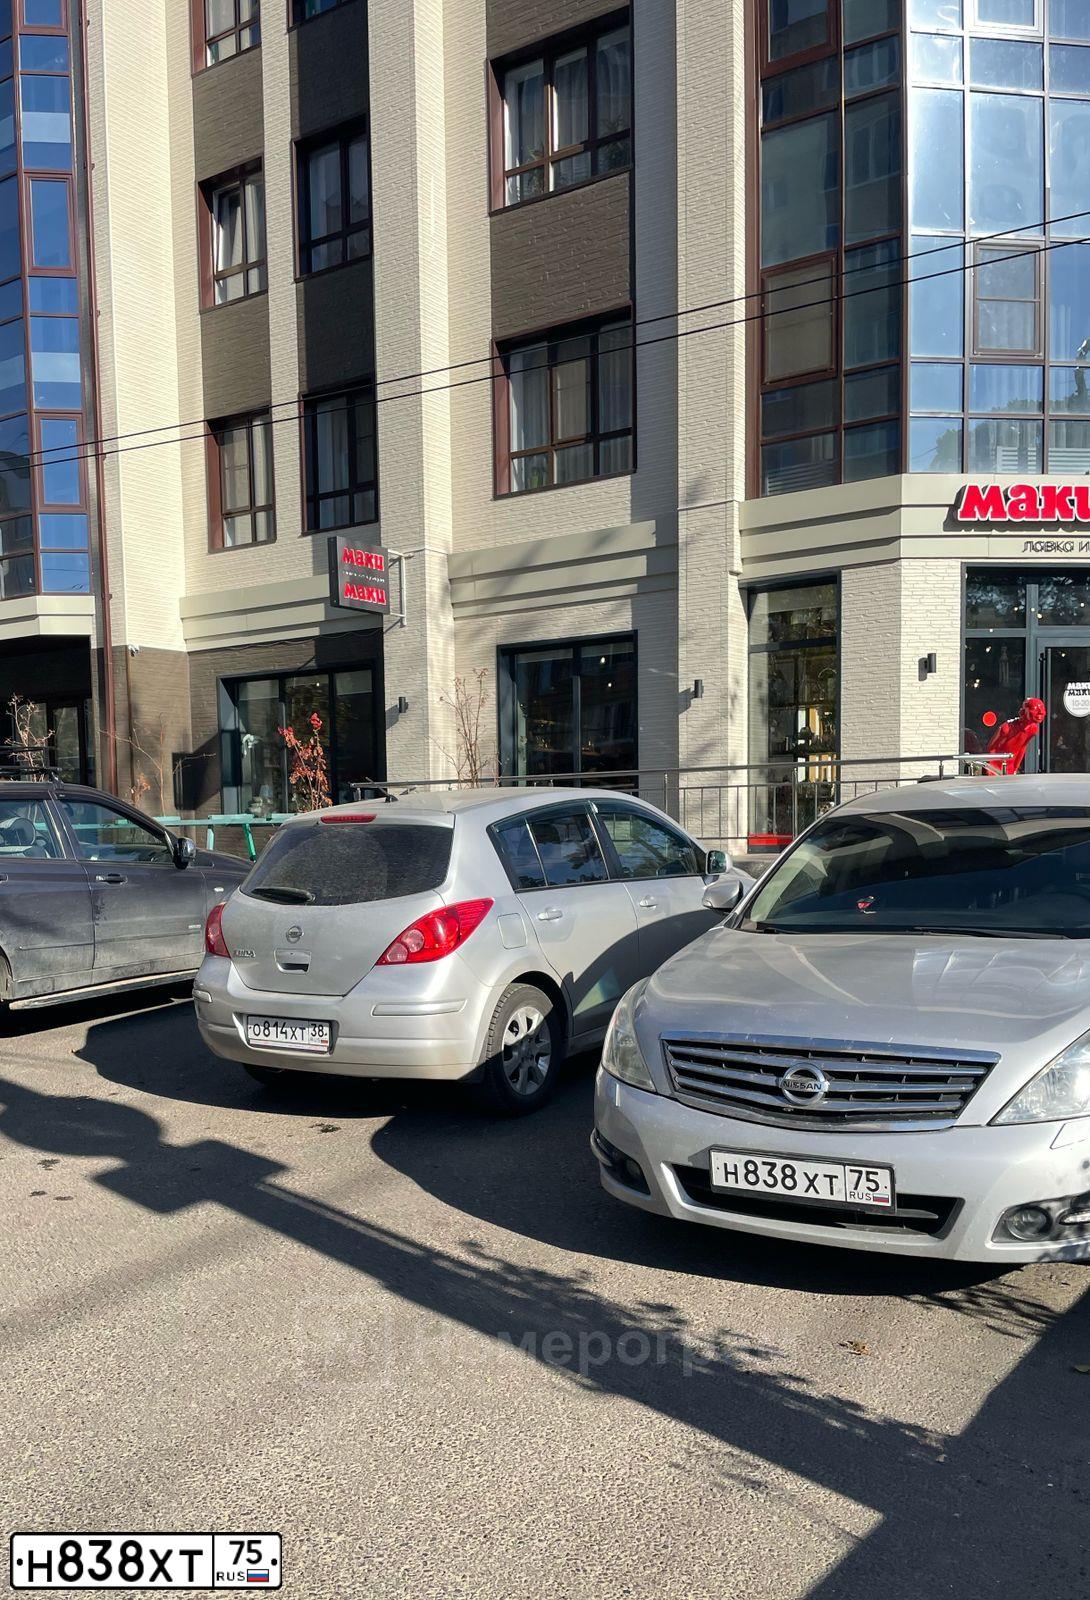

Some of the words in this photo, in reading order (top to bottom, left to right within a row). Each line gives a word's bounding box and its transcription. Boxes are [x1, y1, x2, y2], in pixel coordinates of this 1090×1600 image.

[253, 1020, 306, 1041] О814ХТ
[310, 1023, 325, 1038] 38
[782, 1080, 822, 1090] NISSAN
[723, 1159, 839, 1196] Н838ХТ
[849, 1168, 880, 1193] 75
[849, 1191, 872, 1201] RUS
